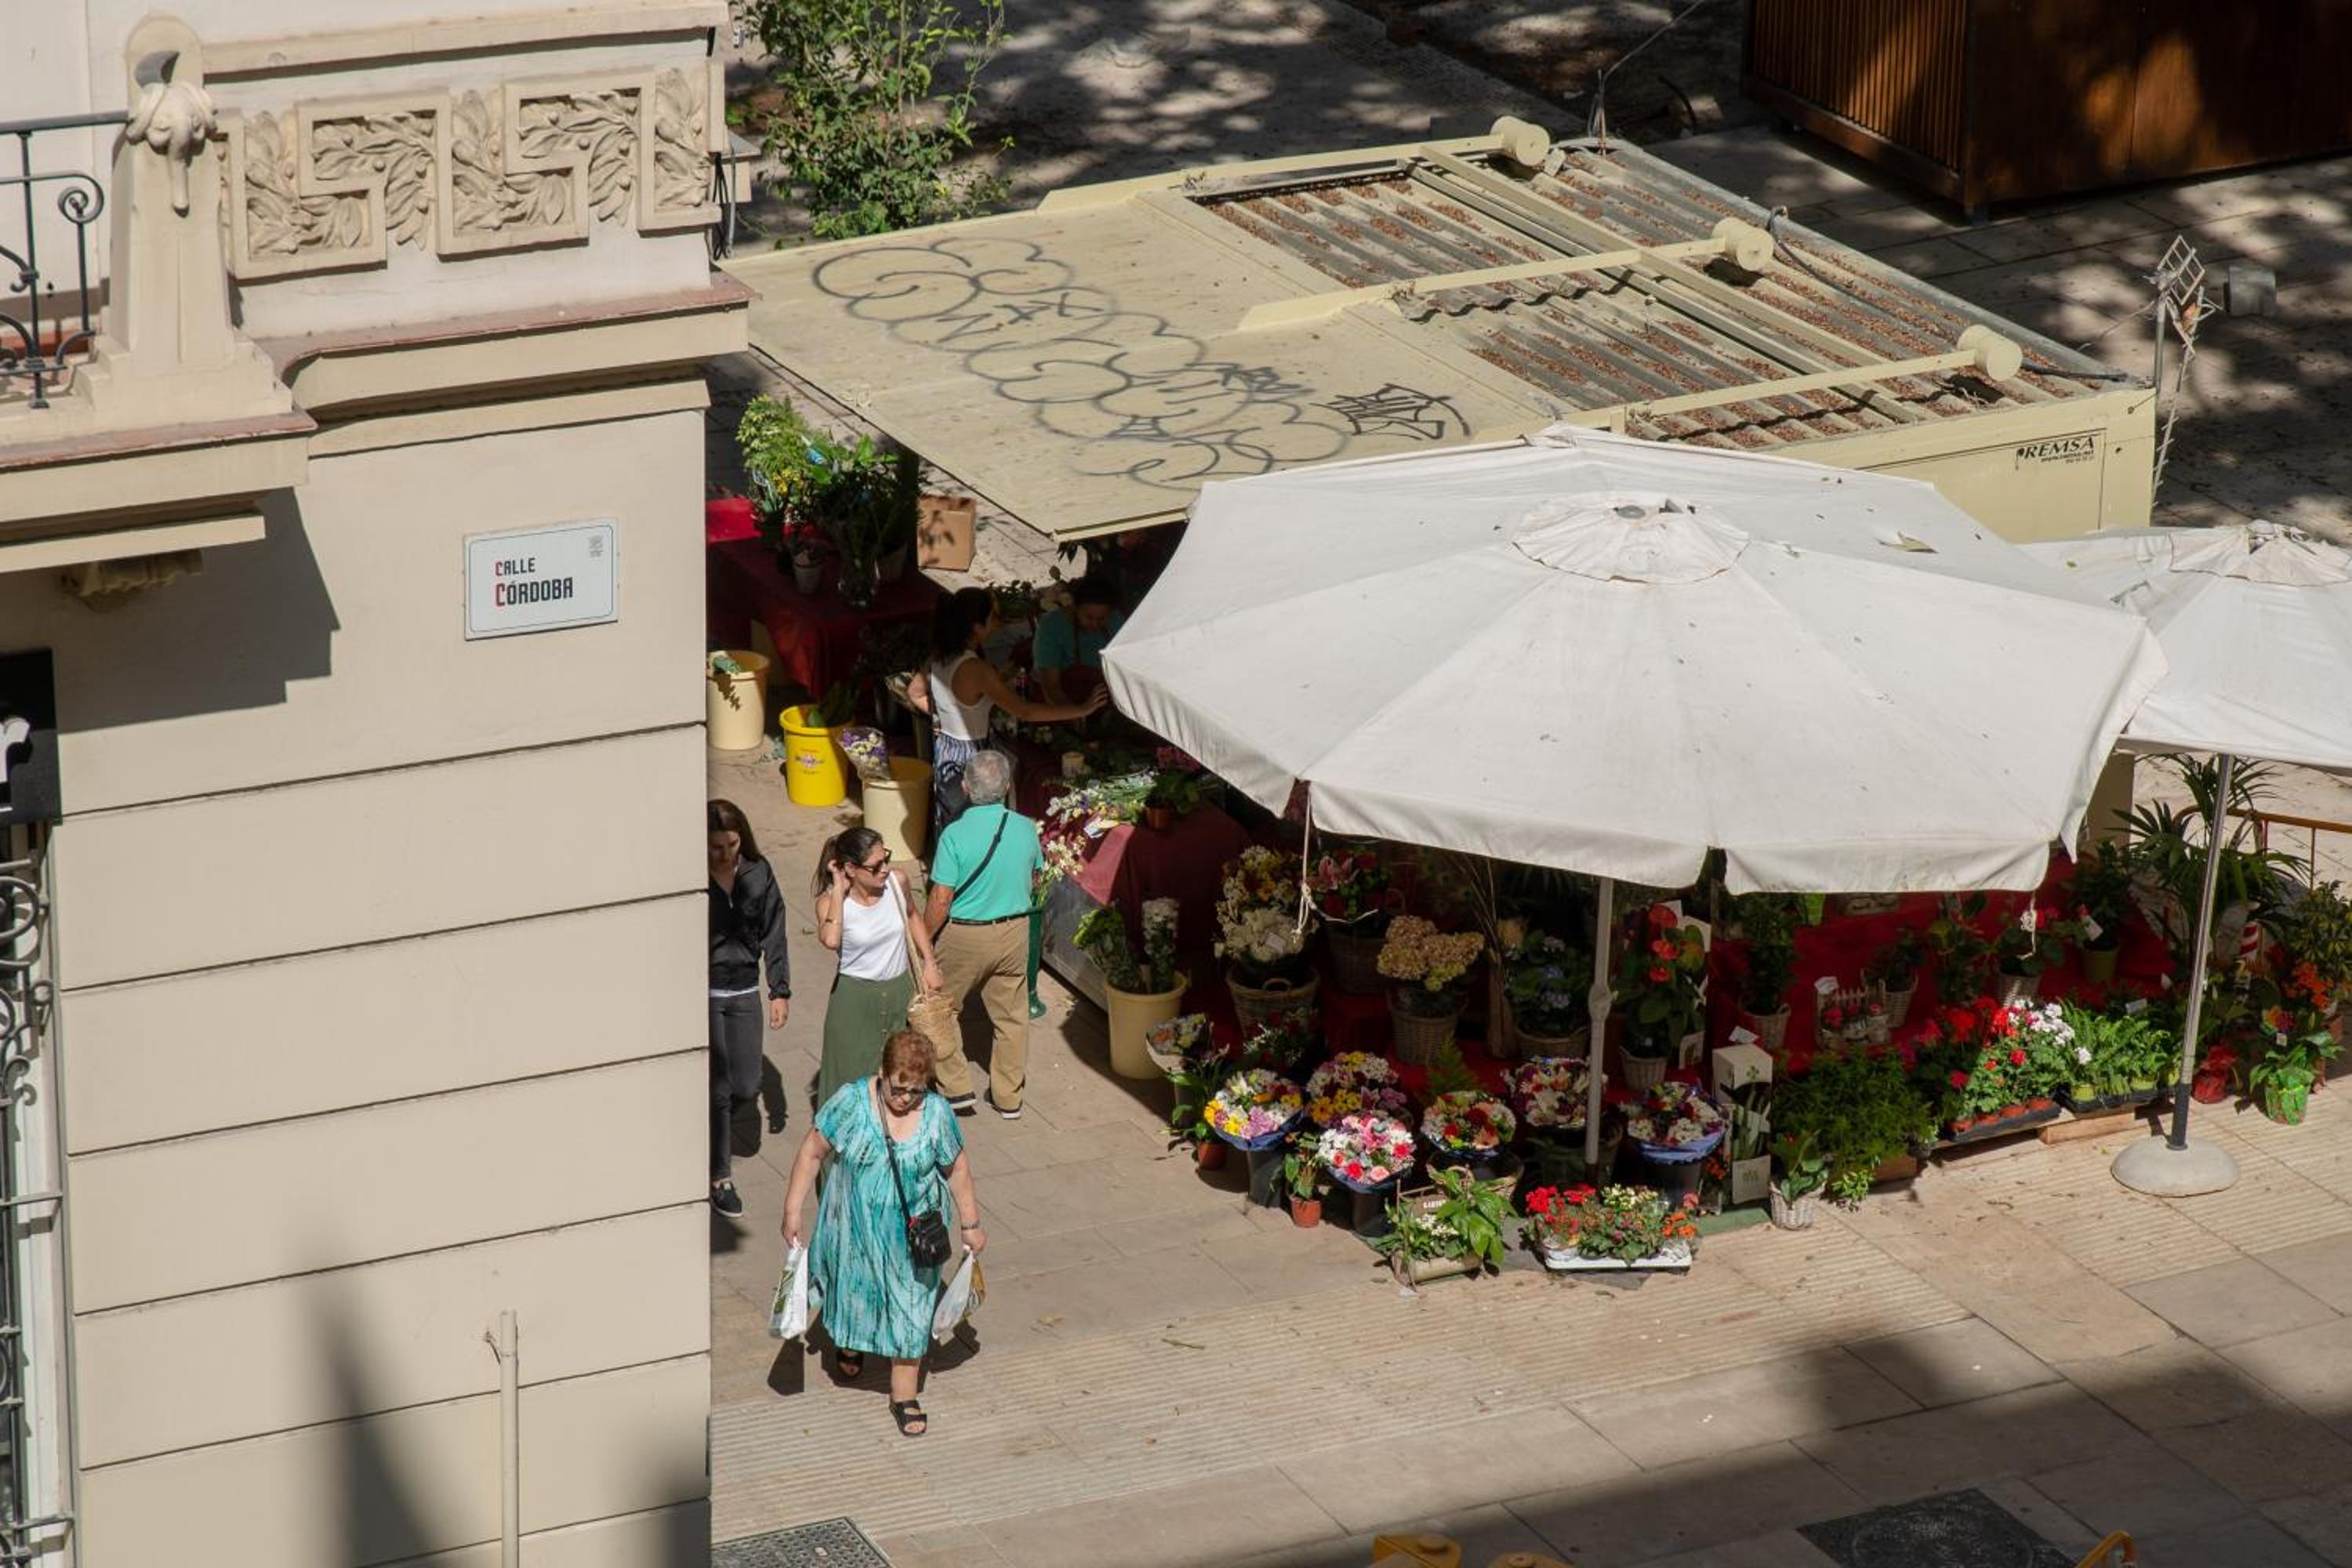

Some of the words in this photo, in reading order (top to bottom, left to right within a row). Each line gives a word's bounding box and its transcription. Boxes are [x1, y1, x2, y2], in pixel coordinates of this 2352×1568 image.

[2024, 436, 2093, 459] REMSA
[495, 557, 535, 576] CALLE
[495, 576, 573, 607] CÓRDOBA
